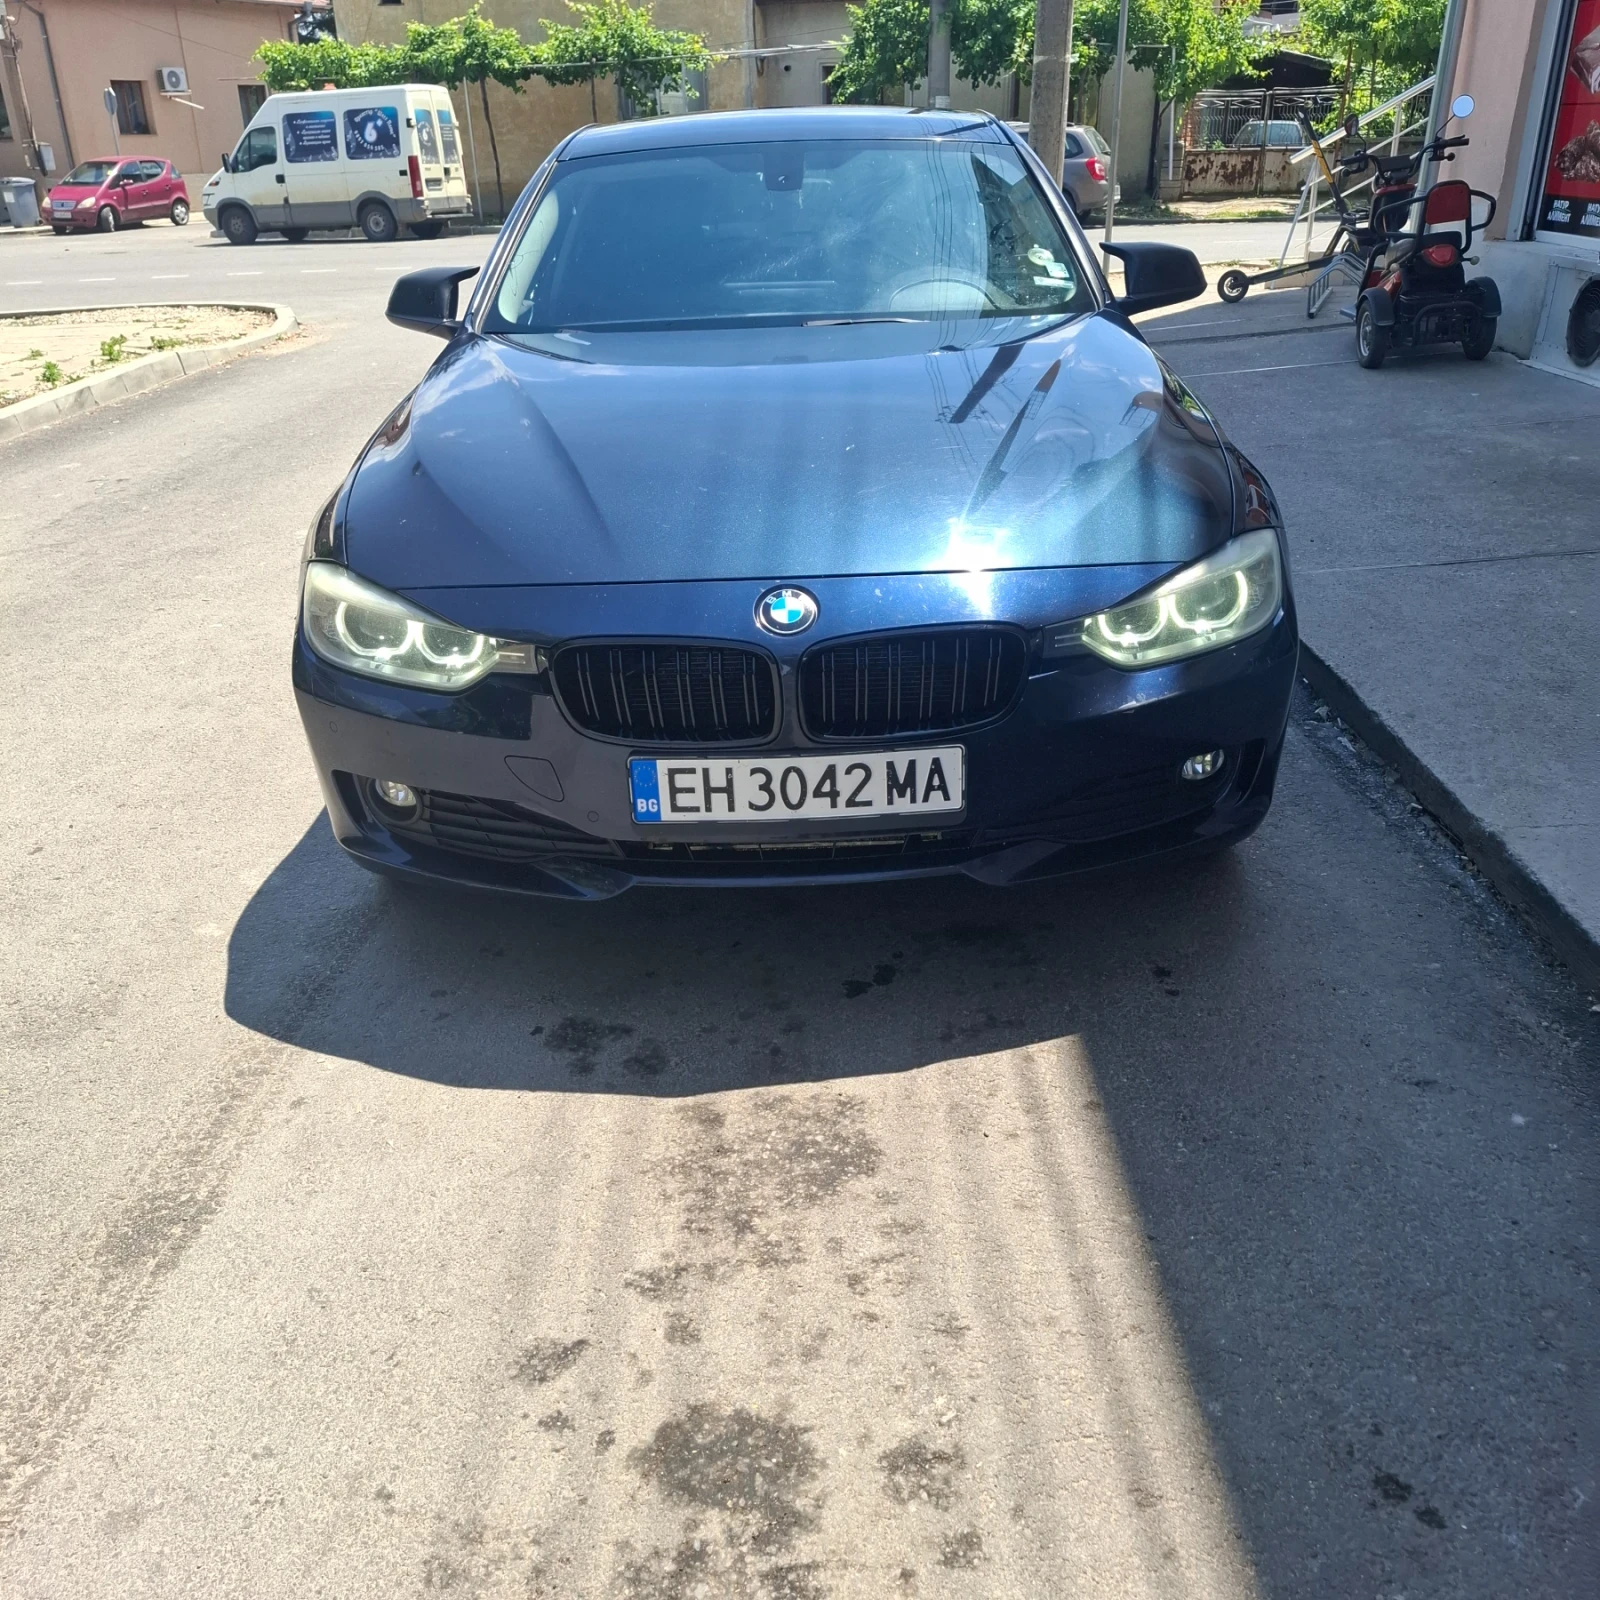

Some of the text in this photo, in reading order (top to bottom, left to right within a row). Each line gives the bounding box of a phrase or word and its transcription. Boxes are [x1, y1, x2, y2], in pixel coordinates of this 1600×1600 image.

[667, 757, 951, 813] EH 3042 MA
[637, 798, 658, 813] BG
